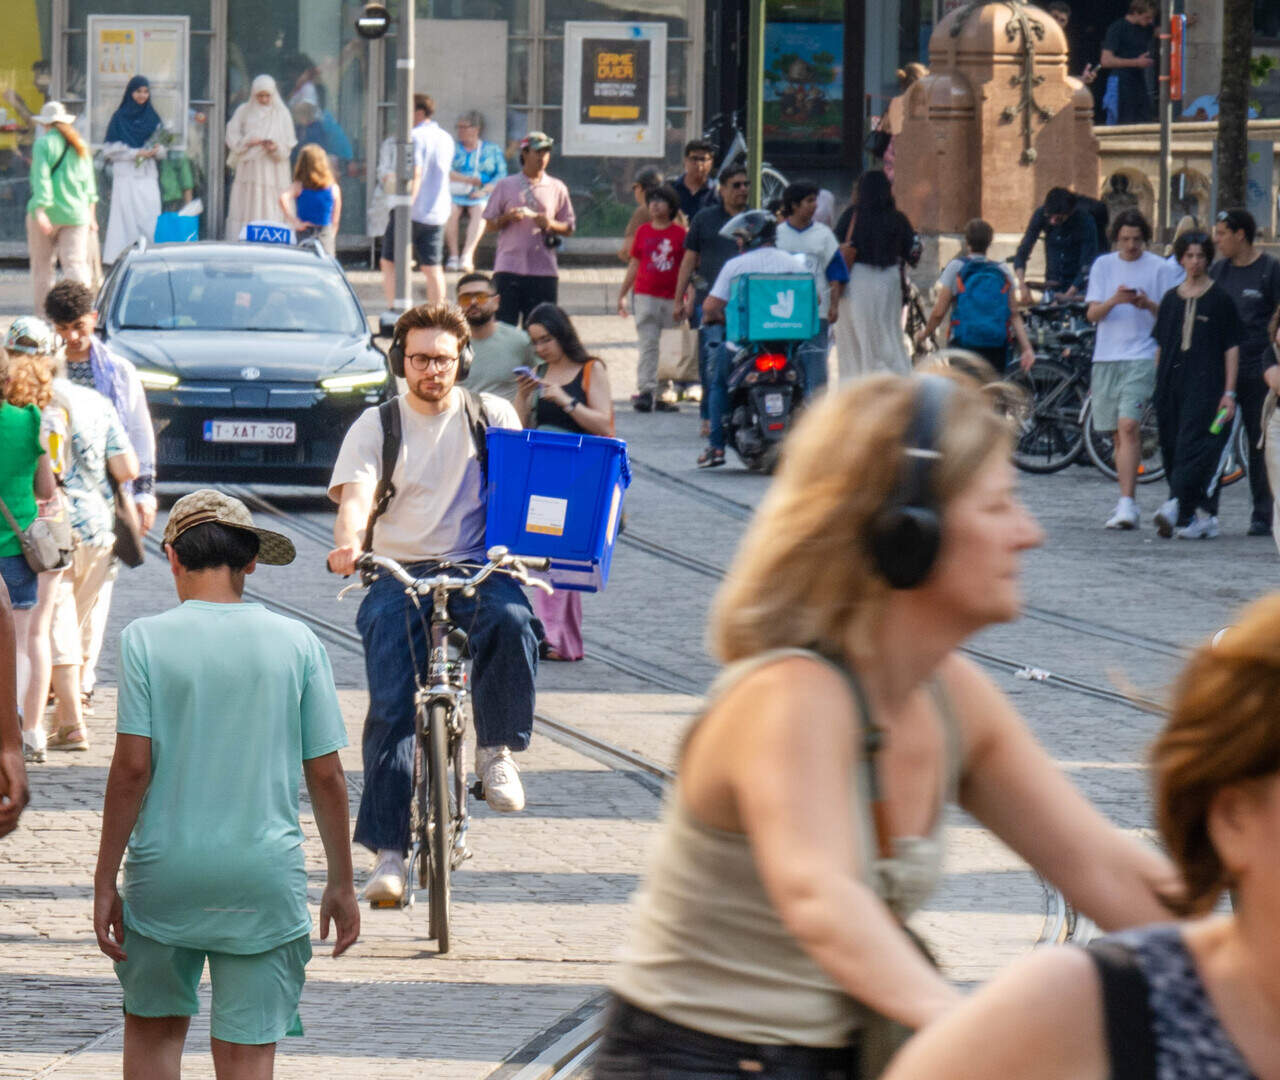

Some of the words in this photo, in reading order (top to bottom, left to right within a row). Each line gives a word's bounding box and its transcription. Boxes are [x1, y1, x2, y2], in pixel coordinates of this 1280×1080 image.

[597, 52, 634, 65] GAME
[597, 65, 634, 79] OVER
[252, 227, 288, 242] TAXI
